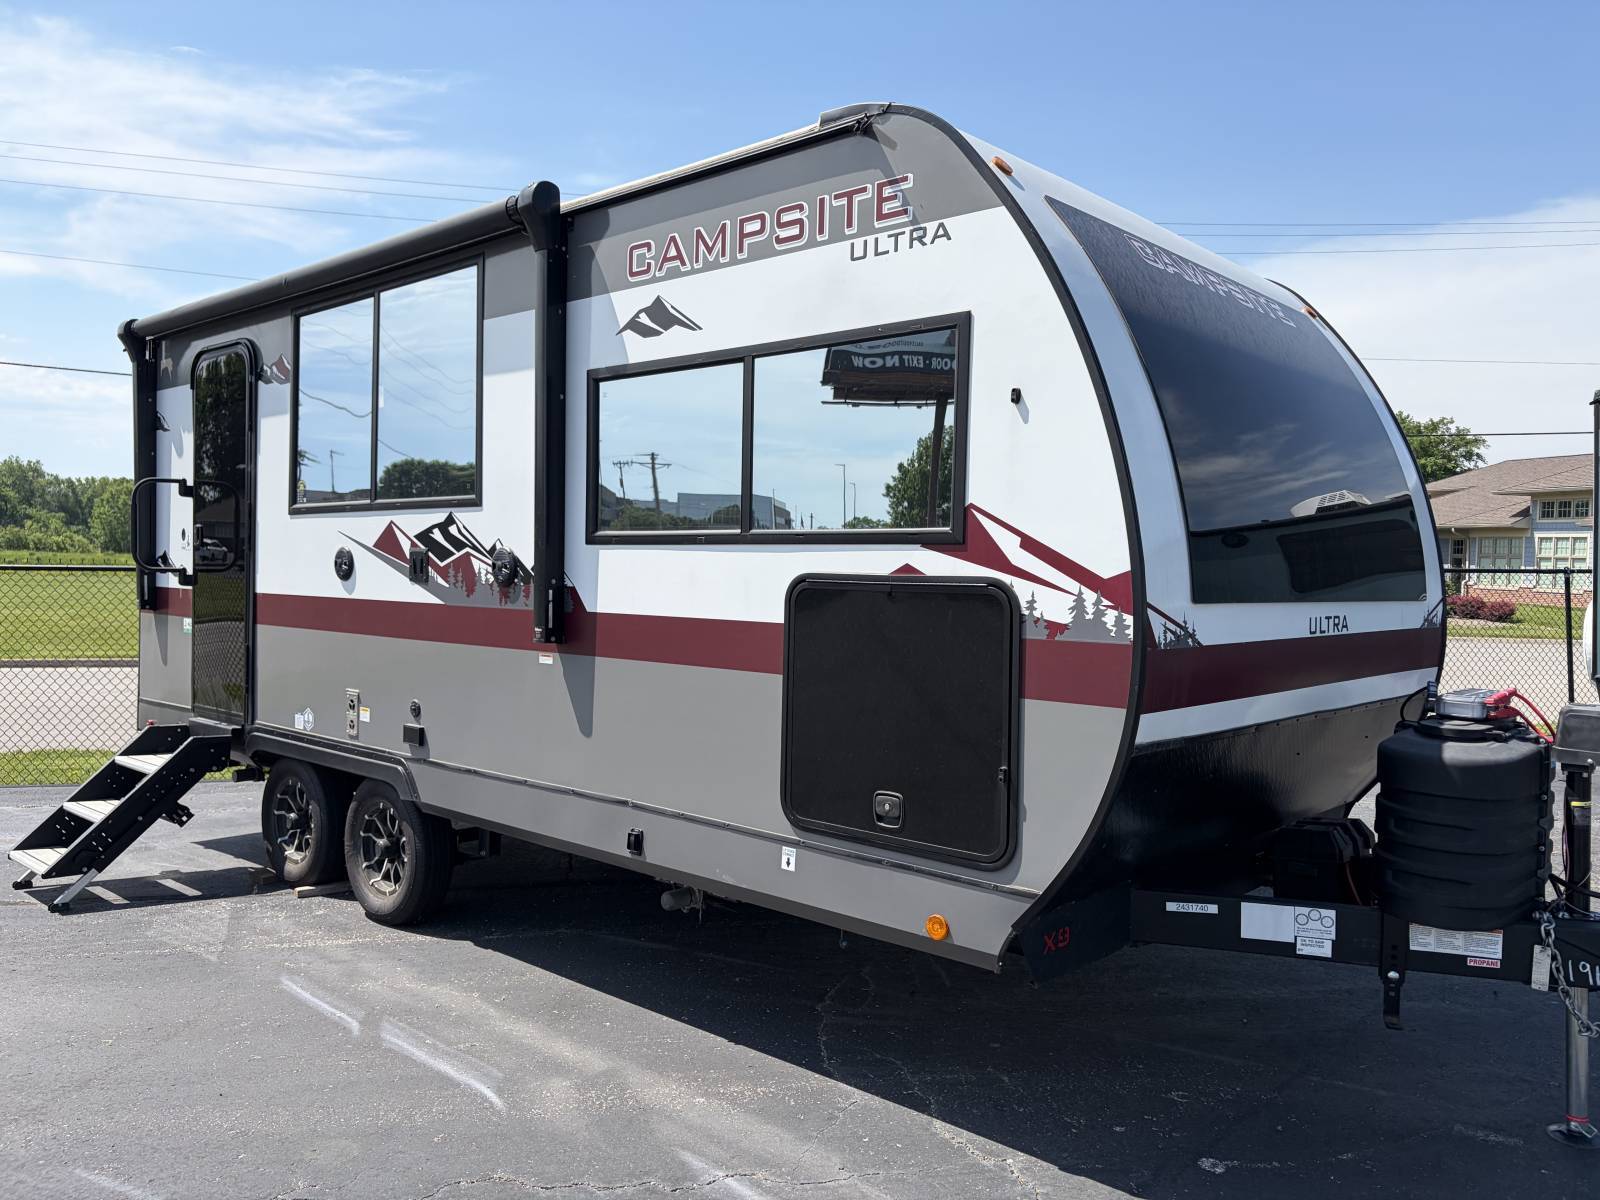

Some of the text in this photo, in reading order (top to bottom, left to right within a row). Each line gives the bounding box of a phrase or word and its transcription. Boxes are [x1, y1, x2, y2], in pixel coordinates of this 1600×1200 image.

[626, 173, 913, 282] CAMPSITE
[850, 221, 952, 262] ULTRA
[1123, 233, 1297, 328] CAMPSITE
[1309, 614, 1349, 635] ULTRA
[1175, 903, 1209, 912] 2431740
[1468, 959, 1499, 968] PROPANE
